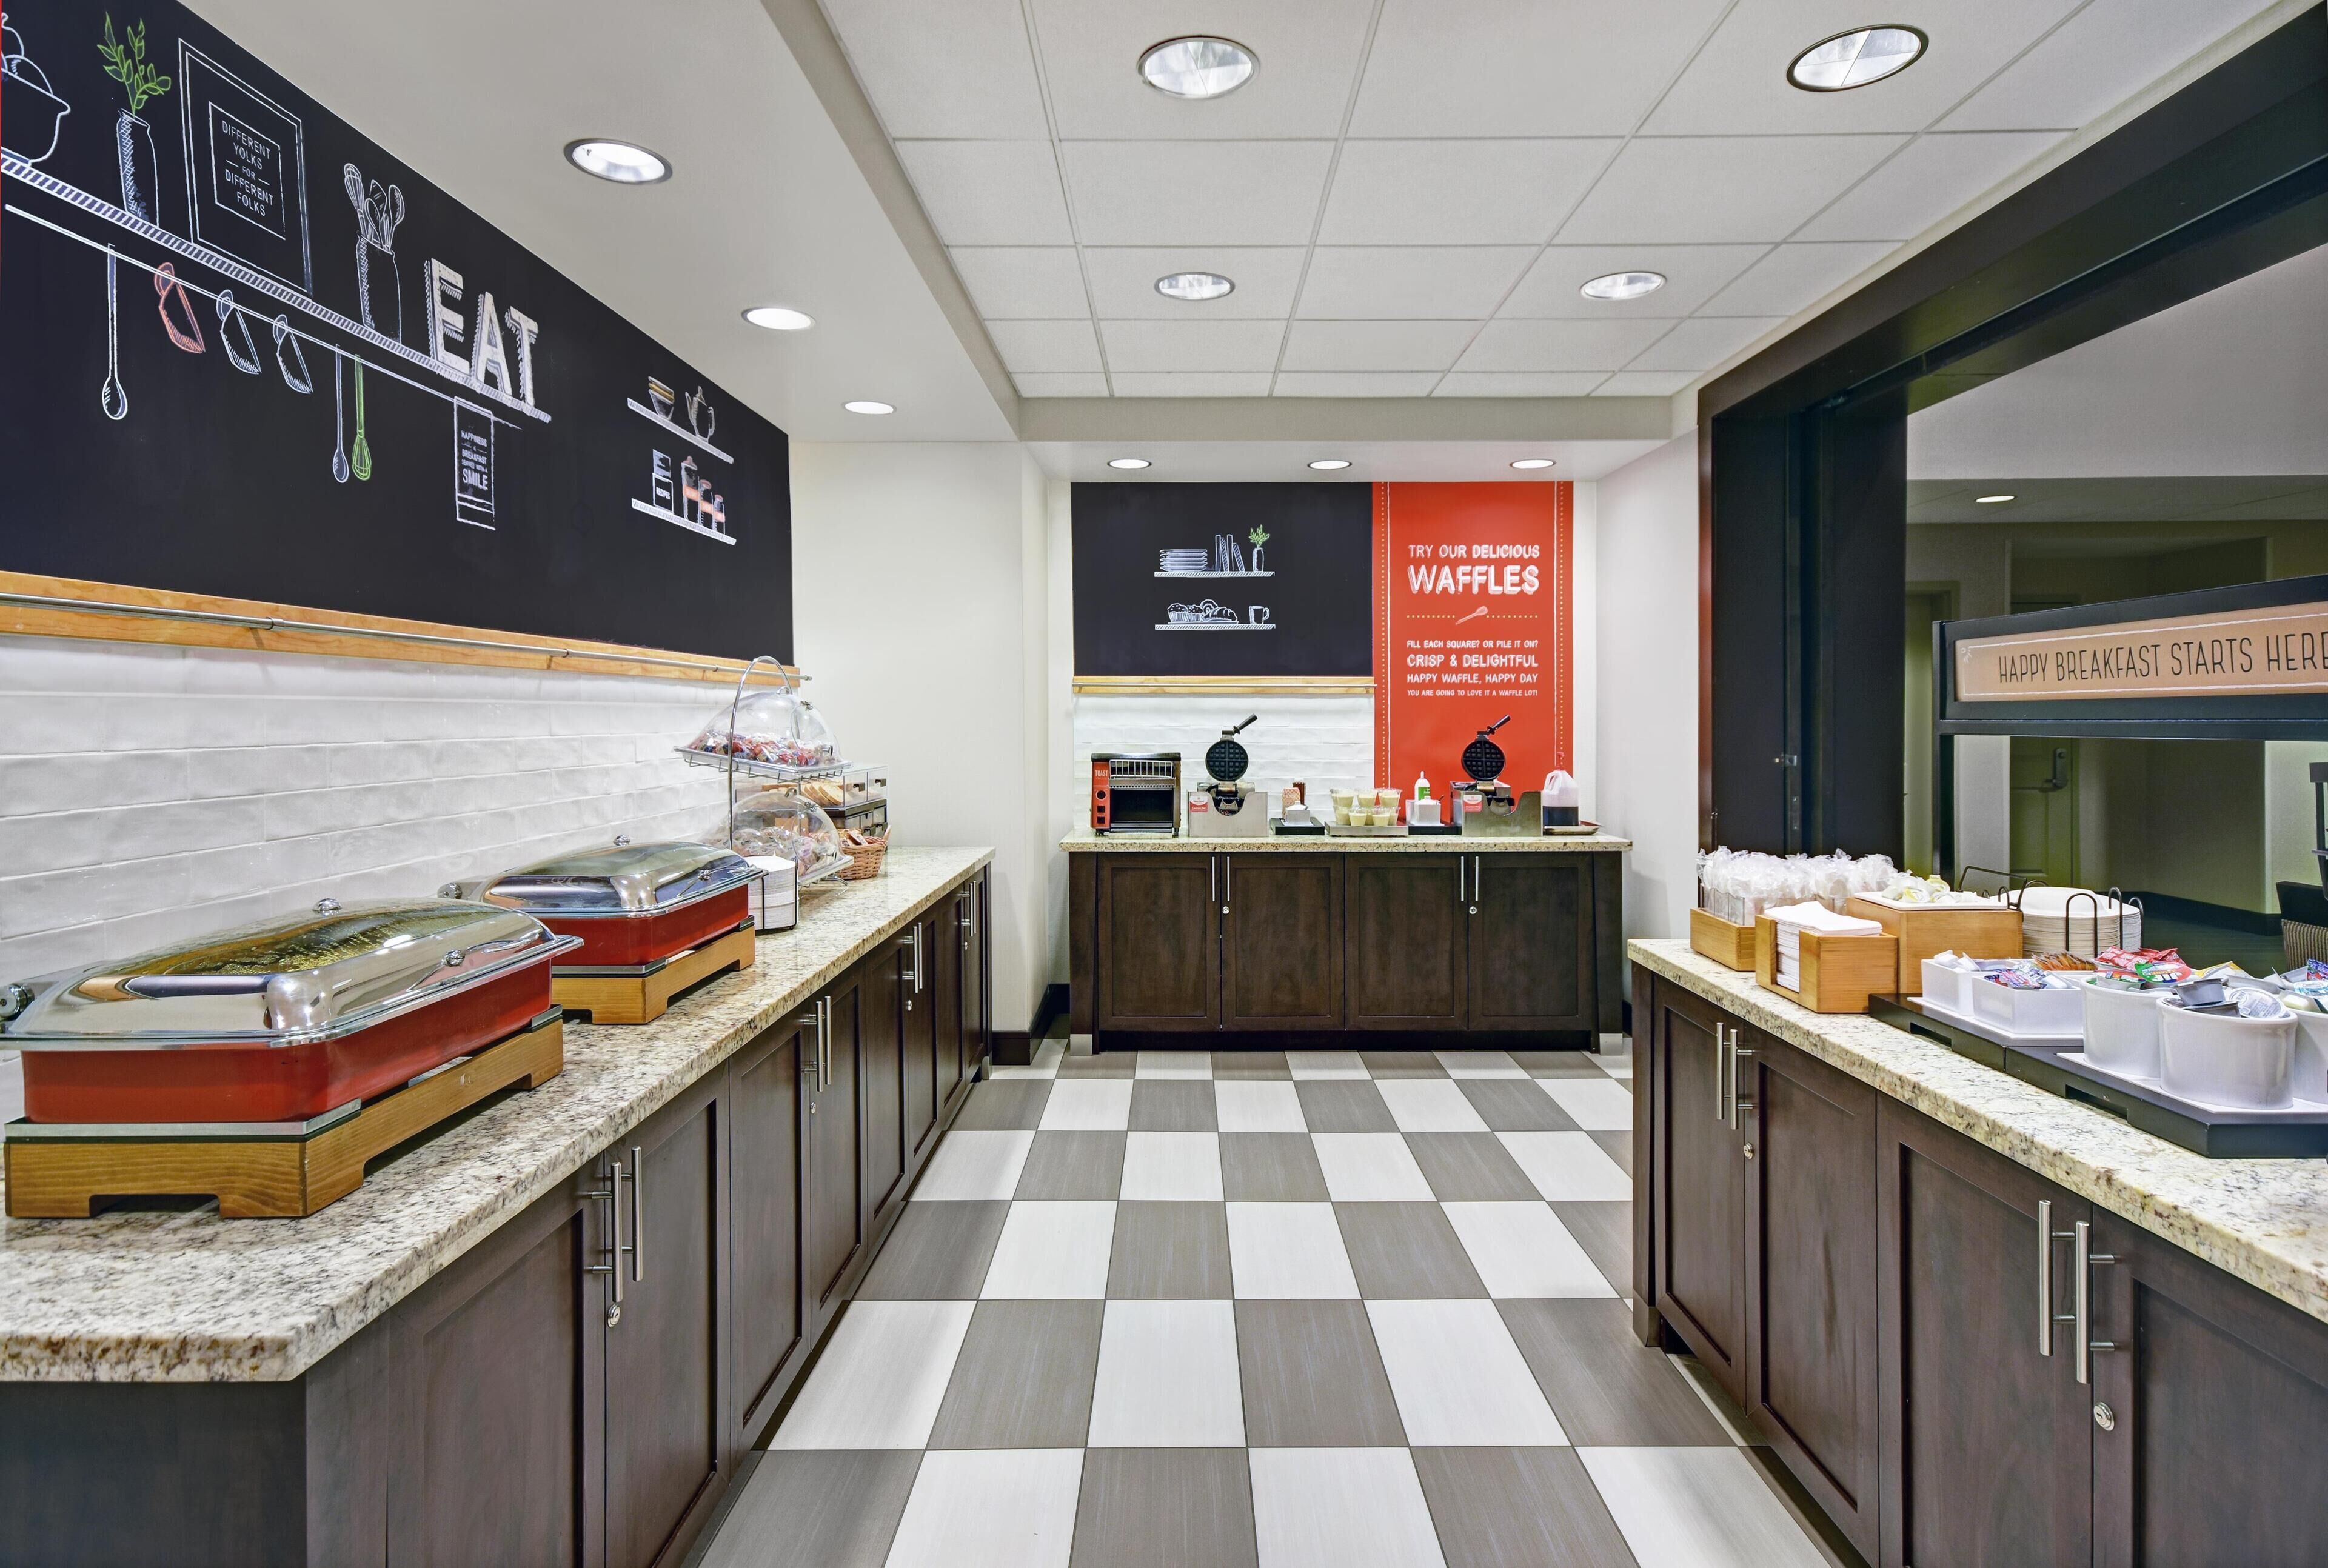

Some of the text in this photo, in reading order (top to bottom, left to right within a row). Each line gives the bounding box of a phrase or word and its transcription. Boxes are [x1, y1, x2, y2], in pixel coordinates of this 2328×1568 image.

[222, 120, 271, 159] DIFFERENT
[233, 142, 263, 170] YOLKS
[242, 165, 256, 180] FOR
[225, 168, 273, 206] DIFFERENT
[236, 191, 266, 216] FOLKS
[424, 258, 539, 407] EAT
[461, 430, 487, 447] HAPPINESS
[463, 469, 488, 490] SMILE
[1408, 544, 1540, 559] TRY OUR DELICIOUS
[1407, 564, 1540, 595] WAFFLES
[1406, 639, 1539, 649] FILL EACH SQUARE? OR PILE IT ON?
[1406, 653, 1539, 668] CRISP & DELIGHTFUL
[1999, 653, 2047, 684] HAPPY
[2056, 644, 2161, 681] BREAKFAST
[2171, 637, 2252, 676] STARTS
[1406, 673, 1538, 684] HAPPY WAFFLE, HAPPY DAY
